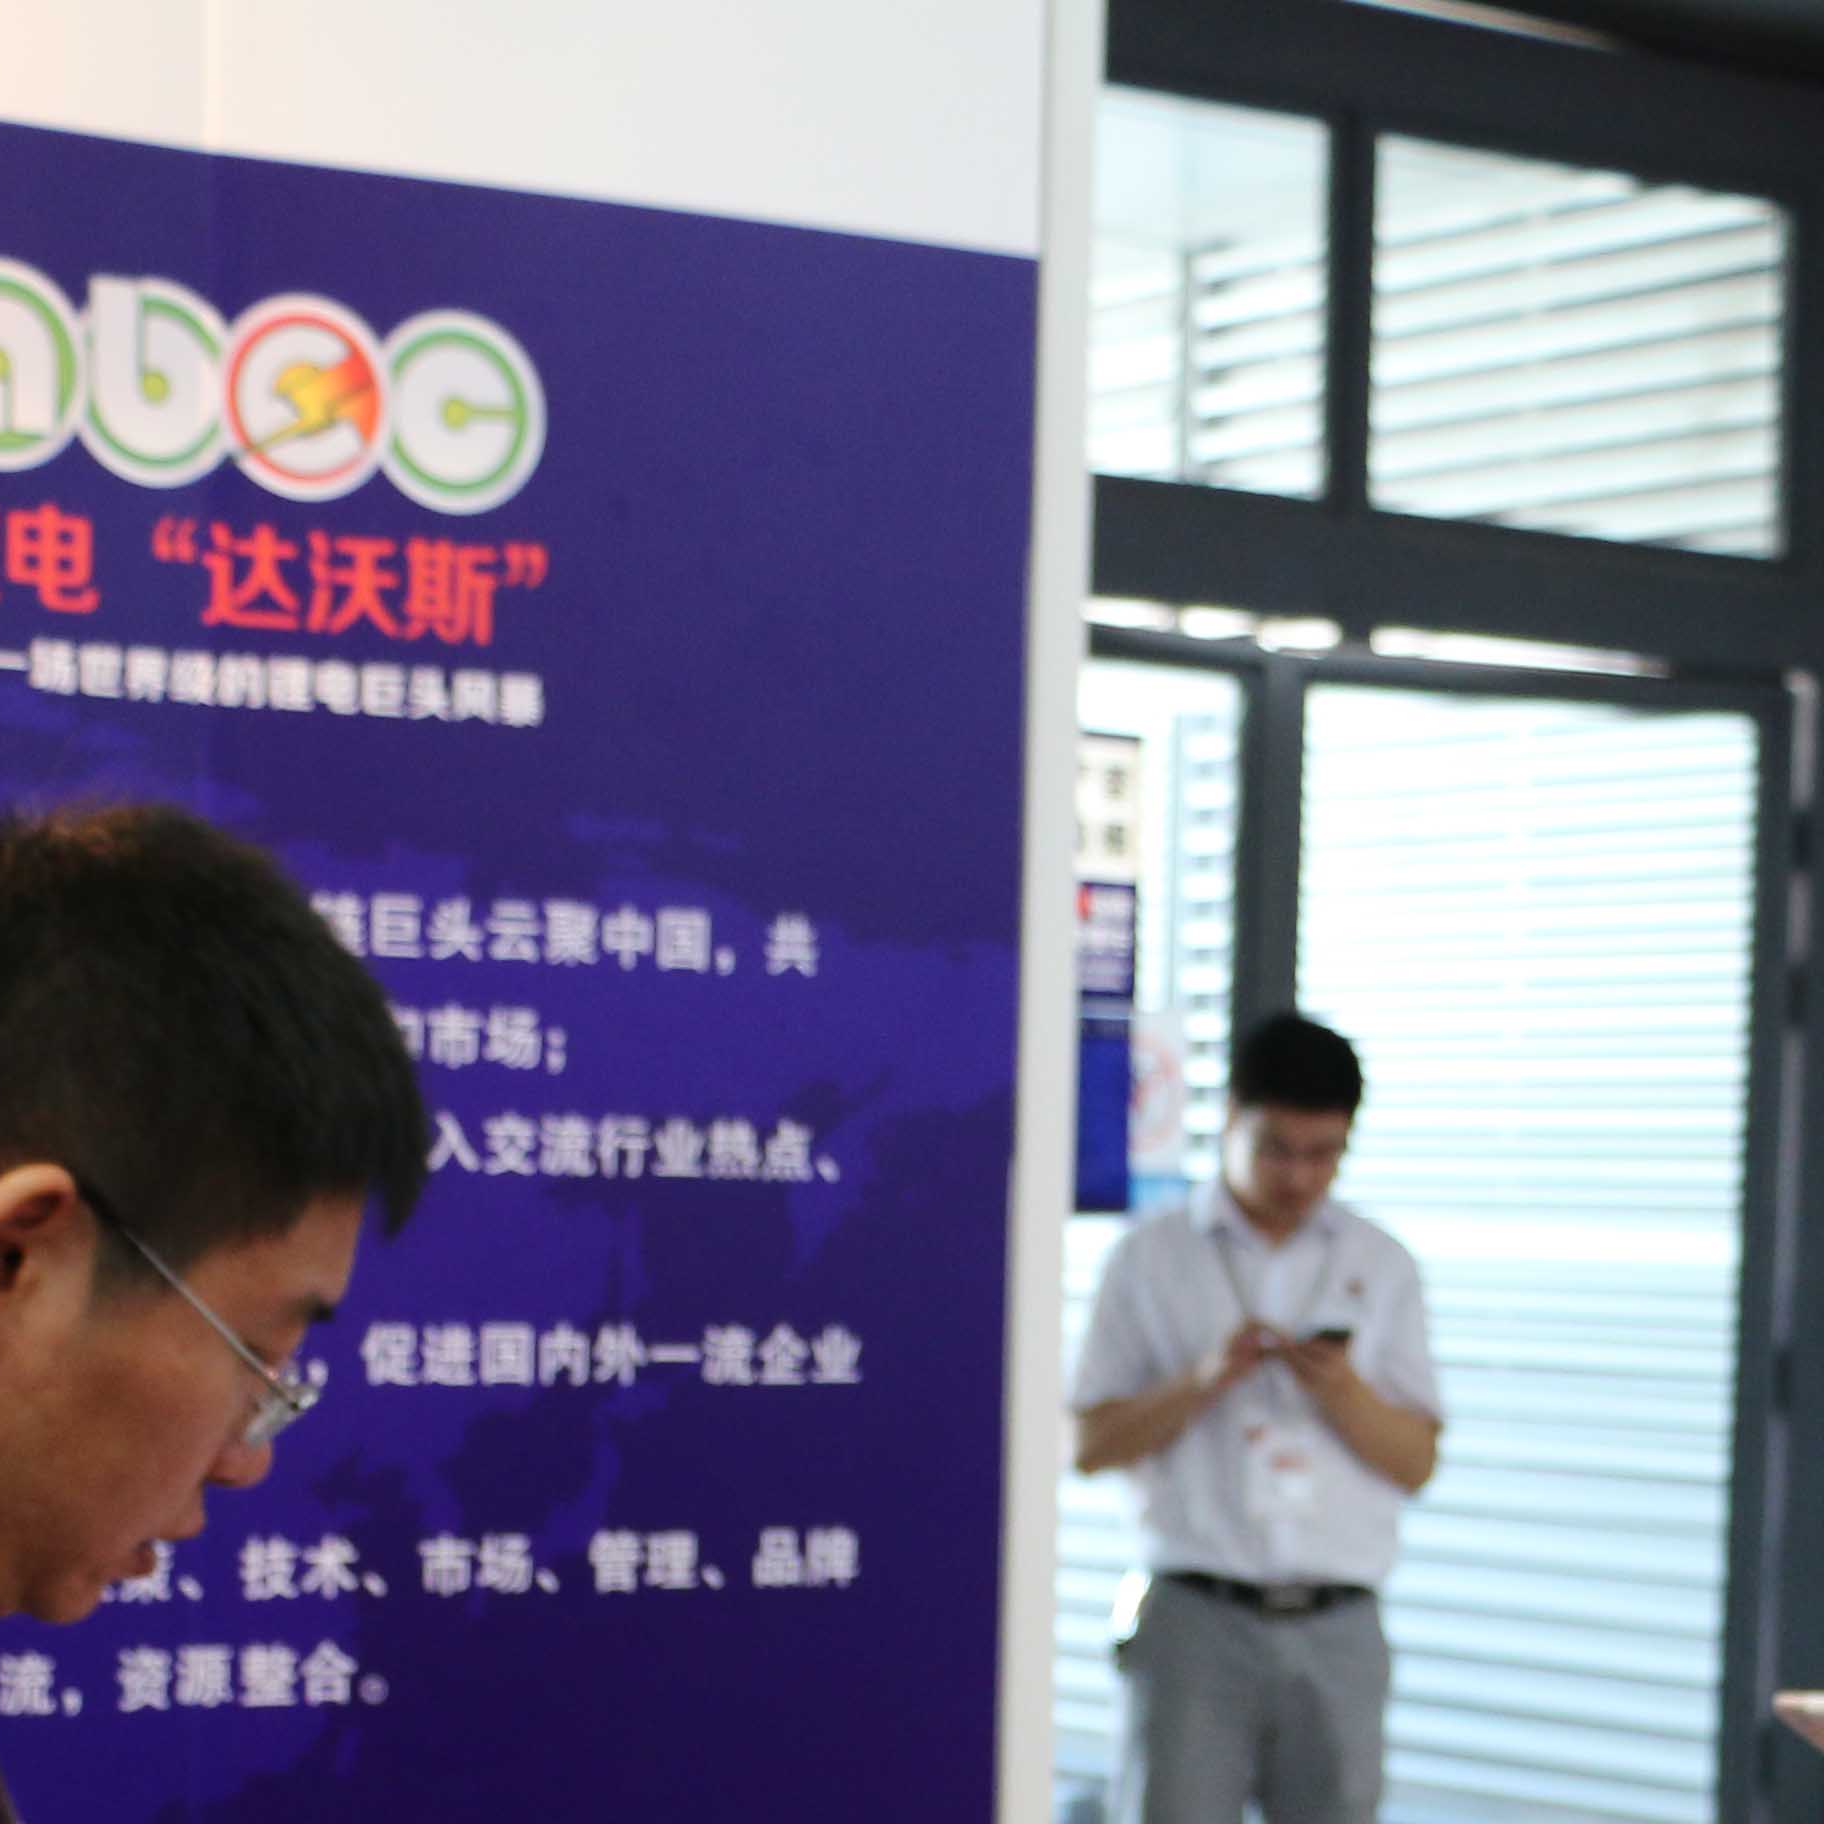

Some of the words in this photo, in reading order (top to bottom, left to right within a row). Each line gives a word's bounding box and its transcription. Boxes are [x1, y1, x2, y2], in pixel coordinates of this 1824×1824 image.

[100, 1526, 862, 1604] 、技术、市场、管理、品牌
